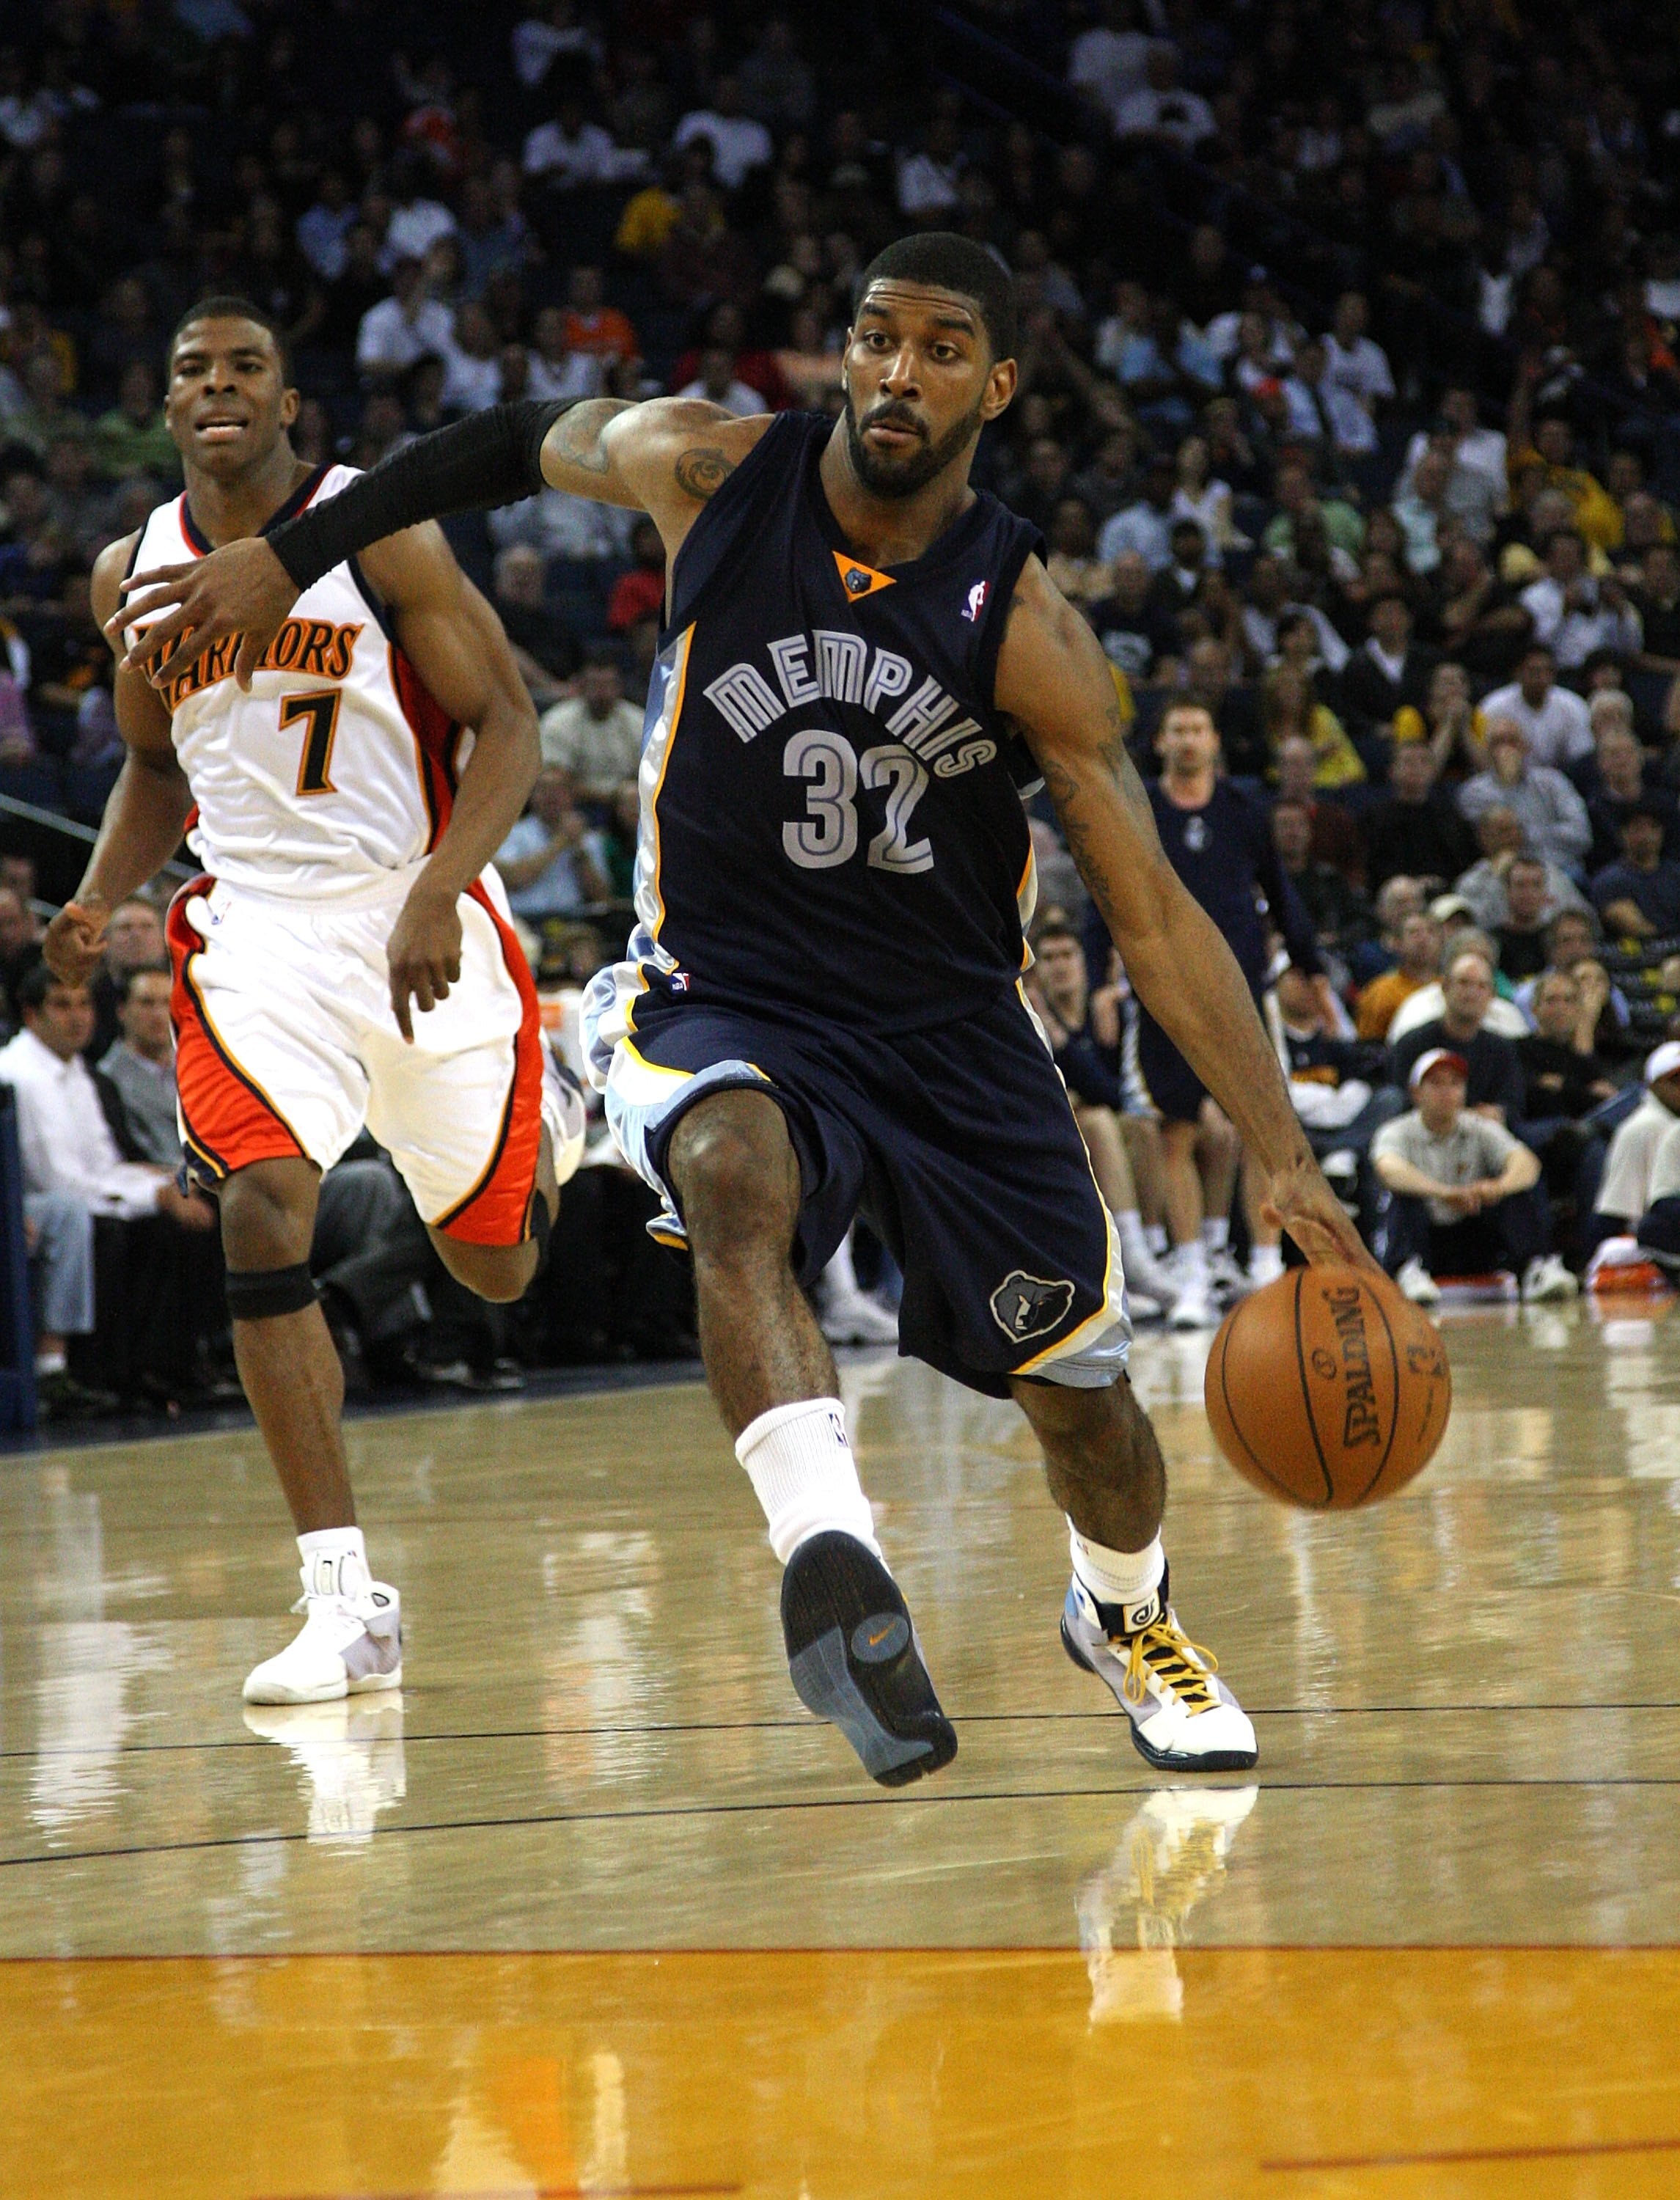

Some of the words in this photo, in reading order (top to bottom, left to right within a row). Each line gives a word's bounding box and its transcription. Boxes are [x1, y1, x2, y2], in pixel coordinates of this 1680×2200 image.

[279, 687, 342, 796] 7
[703, 629, 997, 779] MEMPHIS
[782, 729, 935, 873] 32
[1322, 1286, 1381, 1448] SPALDING
